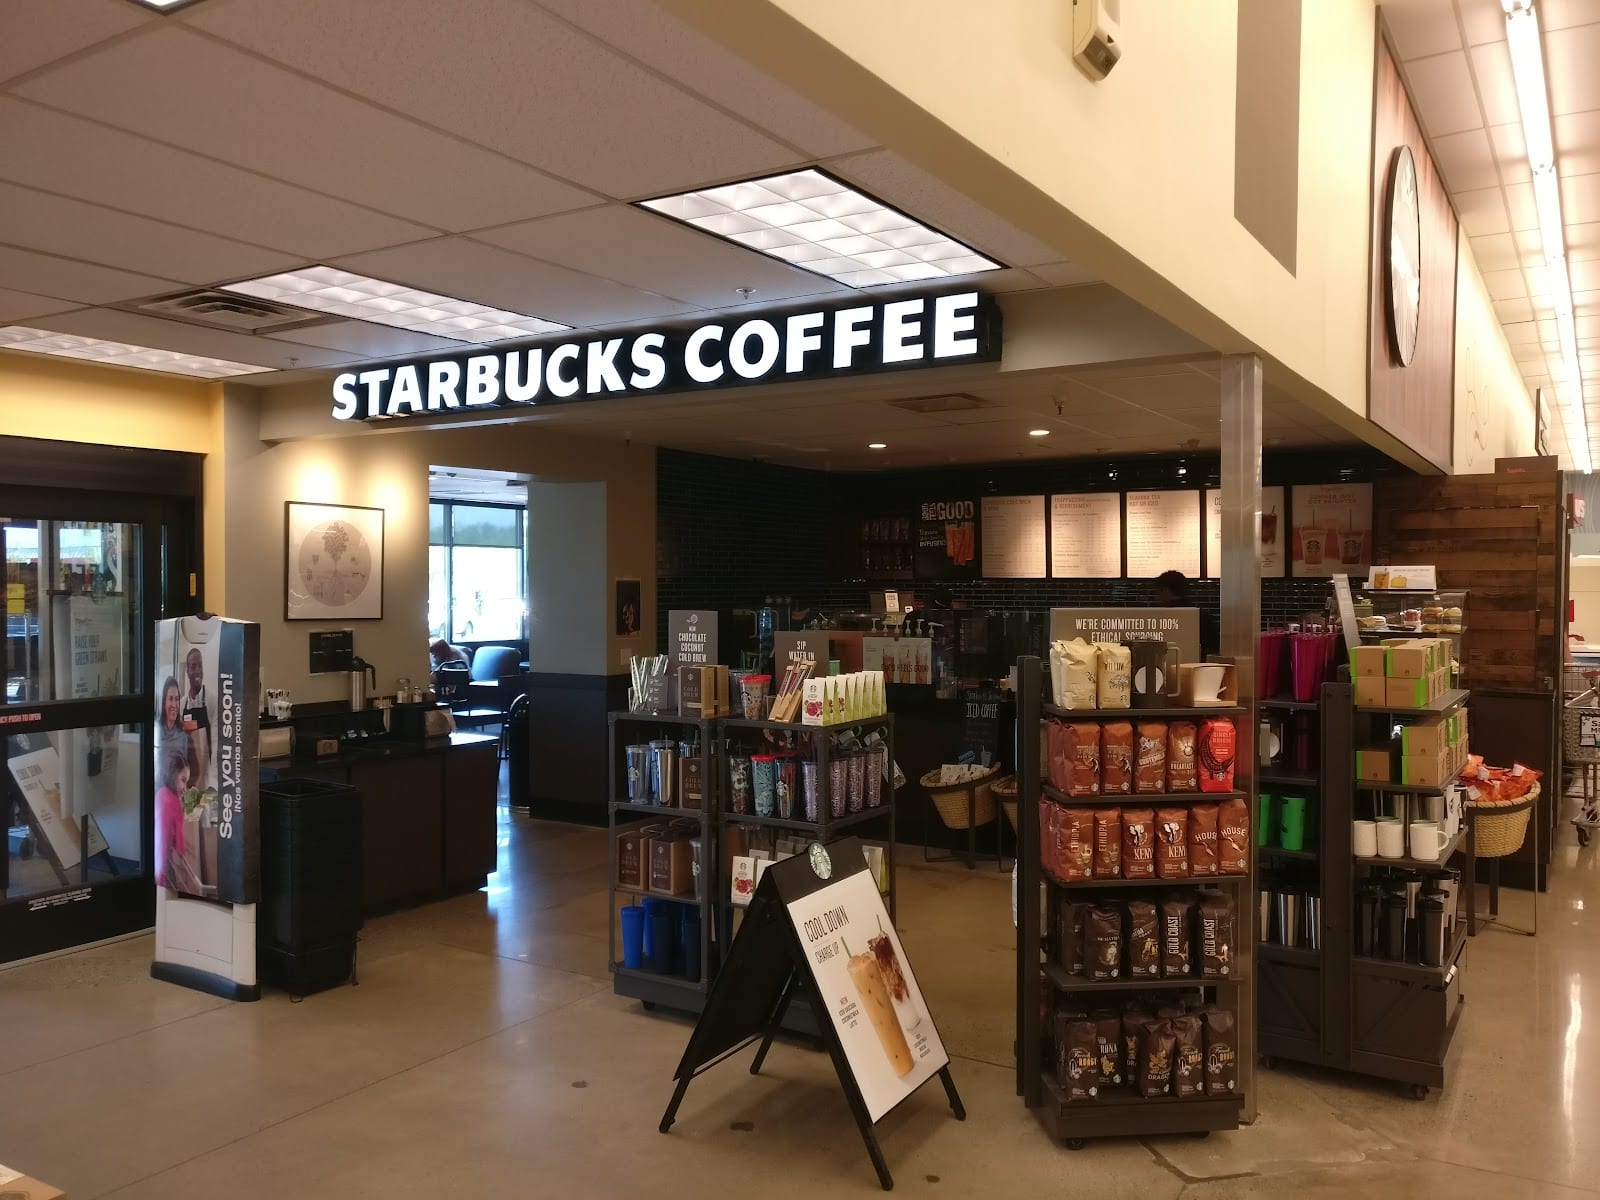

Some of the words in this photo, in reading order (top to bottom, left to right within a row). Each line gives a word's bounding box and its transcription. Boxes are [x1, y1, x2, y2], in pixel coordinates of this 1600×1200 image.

[332, 333, 667, 422] STARBUCKS
[684, 291, 979, 383] COFFEE
[937, 500, 974, 520] GOOD
[1075, 618, 1099, 630] WE'RE
[1101, 618, 1144, 630] COMMITTED
[1147, 618, 1157, 630] TO
[1159, 618, 1179, 630] 100%
[678, 632, 707, 643] CHOCOLATE
[796, 640, 807, 650] SIP
[1091, 632, 1121, 643] ETHICAL
[680, 642, 705, 652] COCONUT
[808, 651, 815, 661] IN
[678, 653, 692, 662] COLD
[692, 653, 707, 663] BREW
[220, 673, 233, 739] soon!
[234, 702, 243, 744] pronto!
[222, 745, 235, 788] you
[219, 793, 233, 840] See
[1071, 821, 1080, 853] ETHIOPIA
[1099, 819, 1108, 852] ETHIOPIA
[1195, 831, 1217, 842] HOUS
[1220, 826, 1246, 838] HOUSE
[804, 916, 828, 943] COOL
[823, 905, 850, 932] DOWN
[1167, 915, 1179, 936] COAST
[1203, 918, 1215, 939] COAST
[815, 944, 835, 964] CHARGE
[1168, 937, 1180, 954] GOLD
[1204, 940, 1216, 957] GOLD
[1078, 1057, 1097, 1067] ROAST
